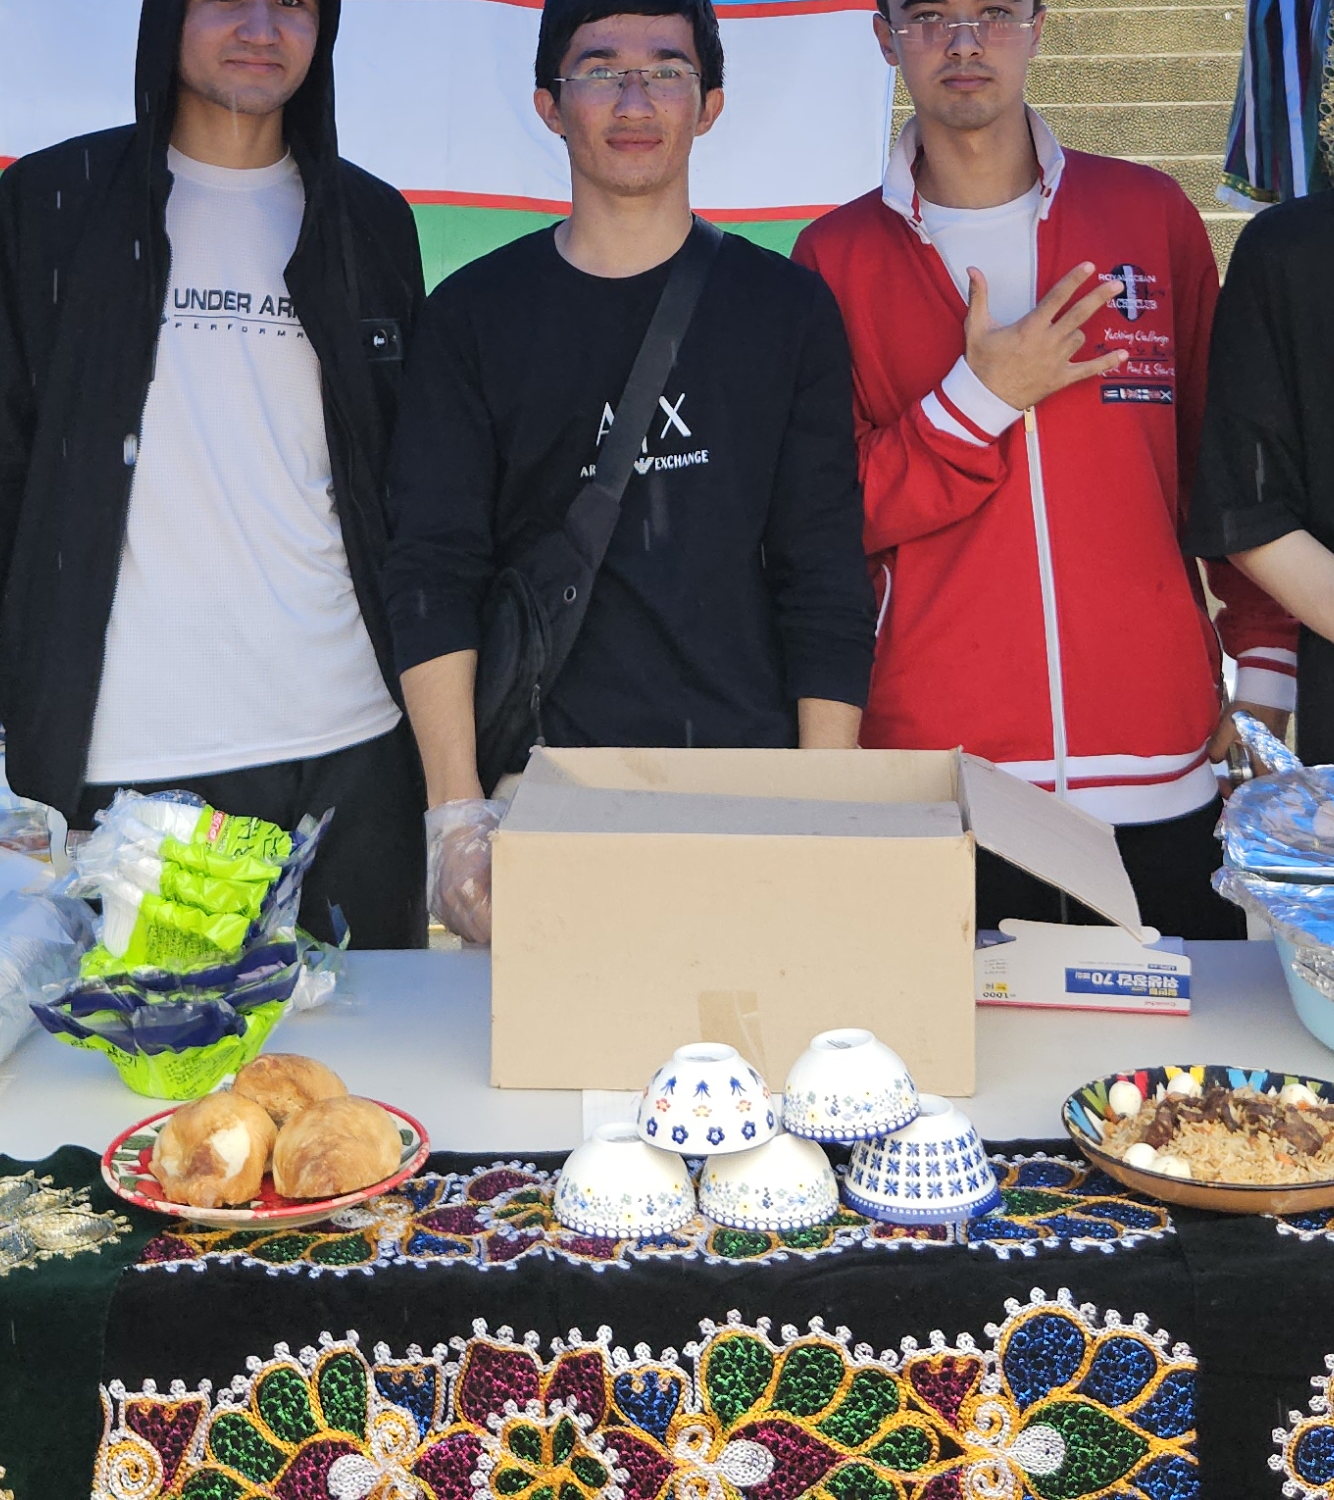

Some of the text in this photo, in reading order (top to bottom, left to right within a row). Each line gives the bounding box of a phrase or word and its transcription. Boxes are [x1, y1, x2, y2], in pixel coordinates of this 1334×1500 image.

[174, 287, 251, 314] UNDER
[654, 450, 709, 471] EXCHANGE
[1091, 972, 1114, 986] 70
[1117, 973, 1179, 988] 위생장갑
